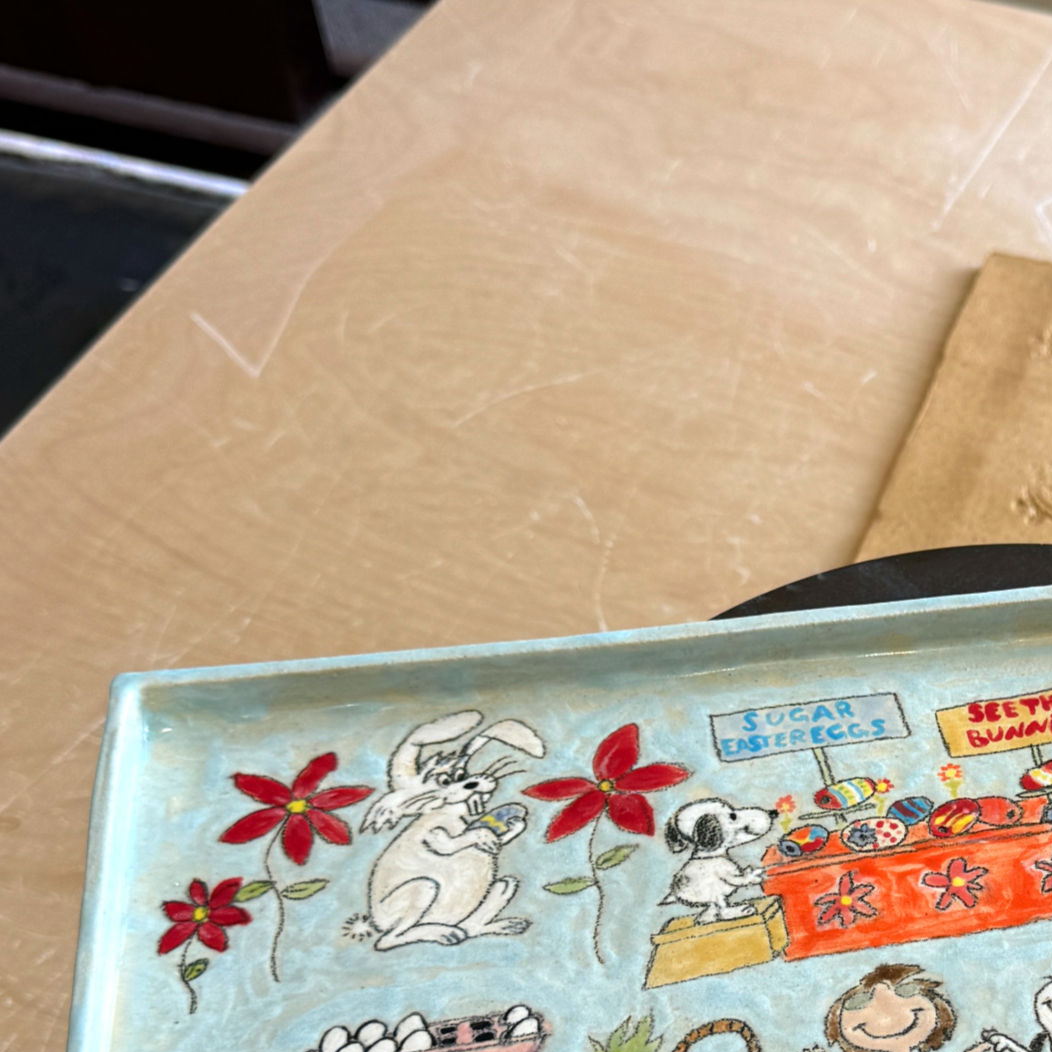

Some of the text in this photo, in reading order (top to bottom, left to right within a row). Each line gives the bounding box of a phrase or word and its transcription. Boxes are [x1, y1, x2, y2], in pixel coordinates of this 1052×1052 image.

[742, 700, 854, 732] SUGAR
[967, 701, 1019, 723] SEE
[719, 718, 886, 756] EASTER EGGS
